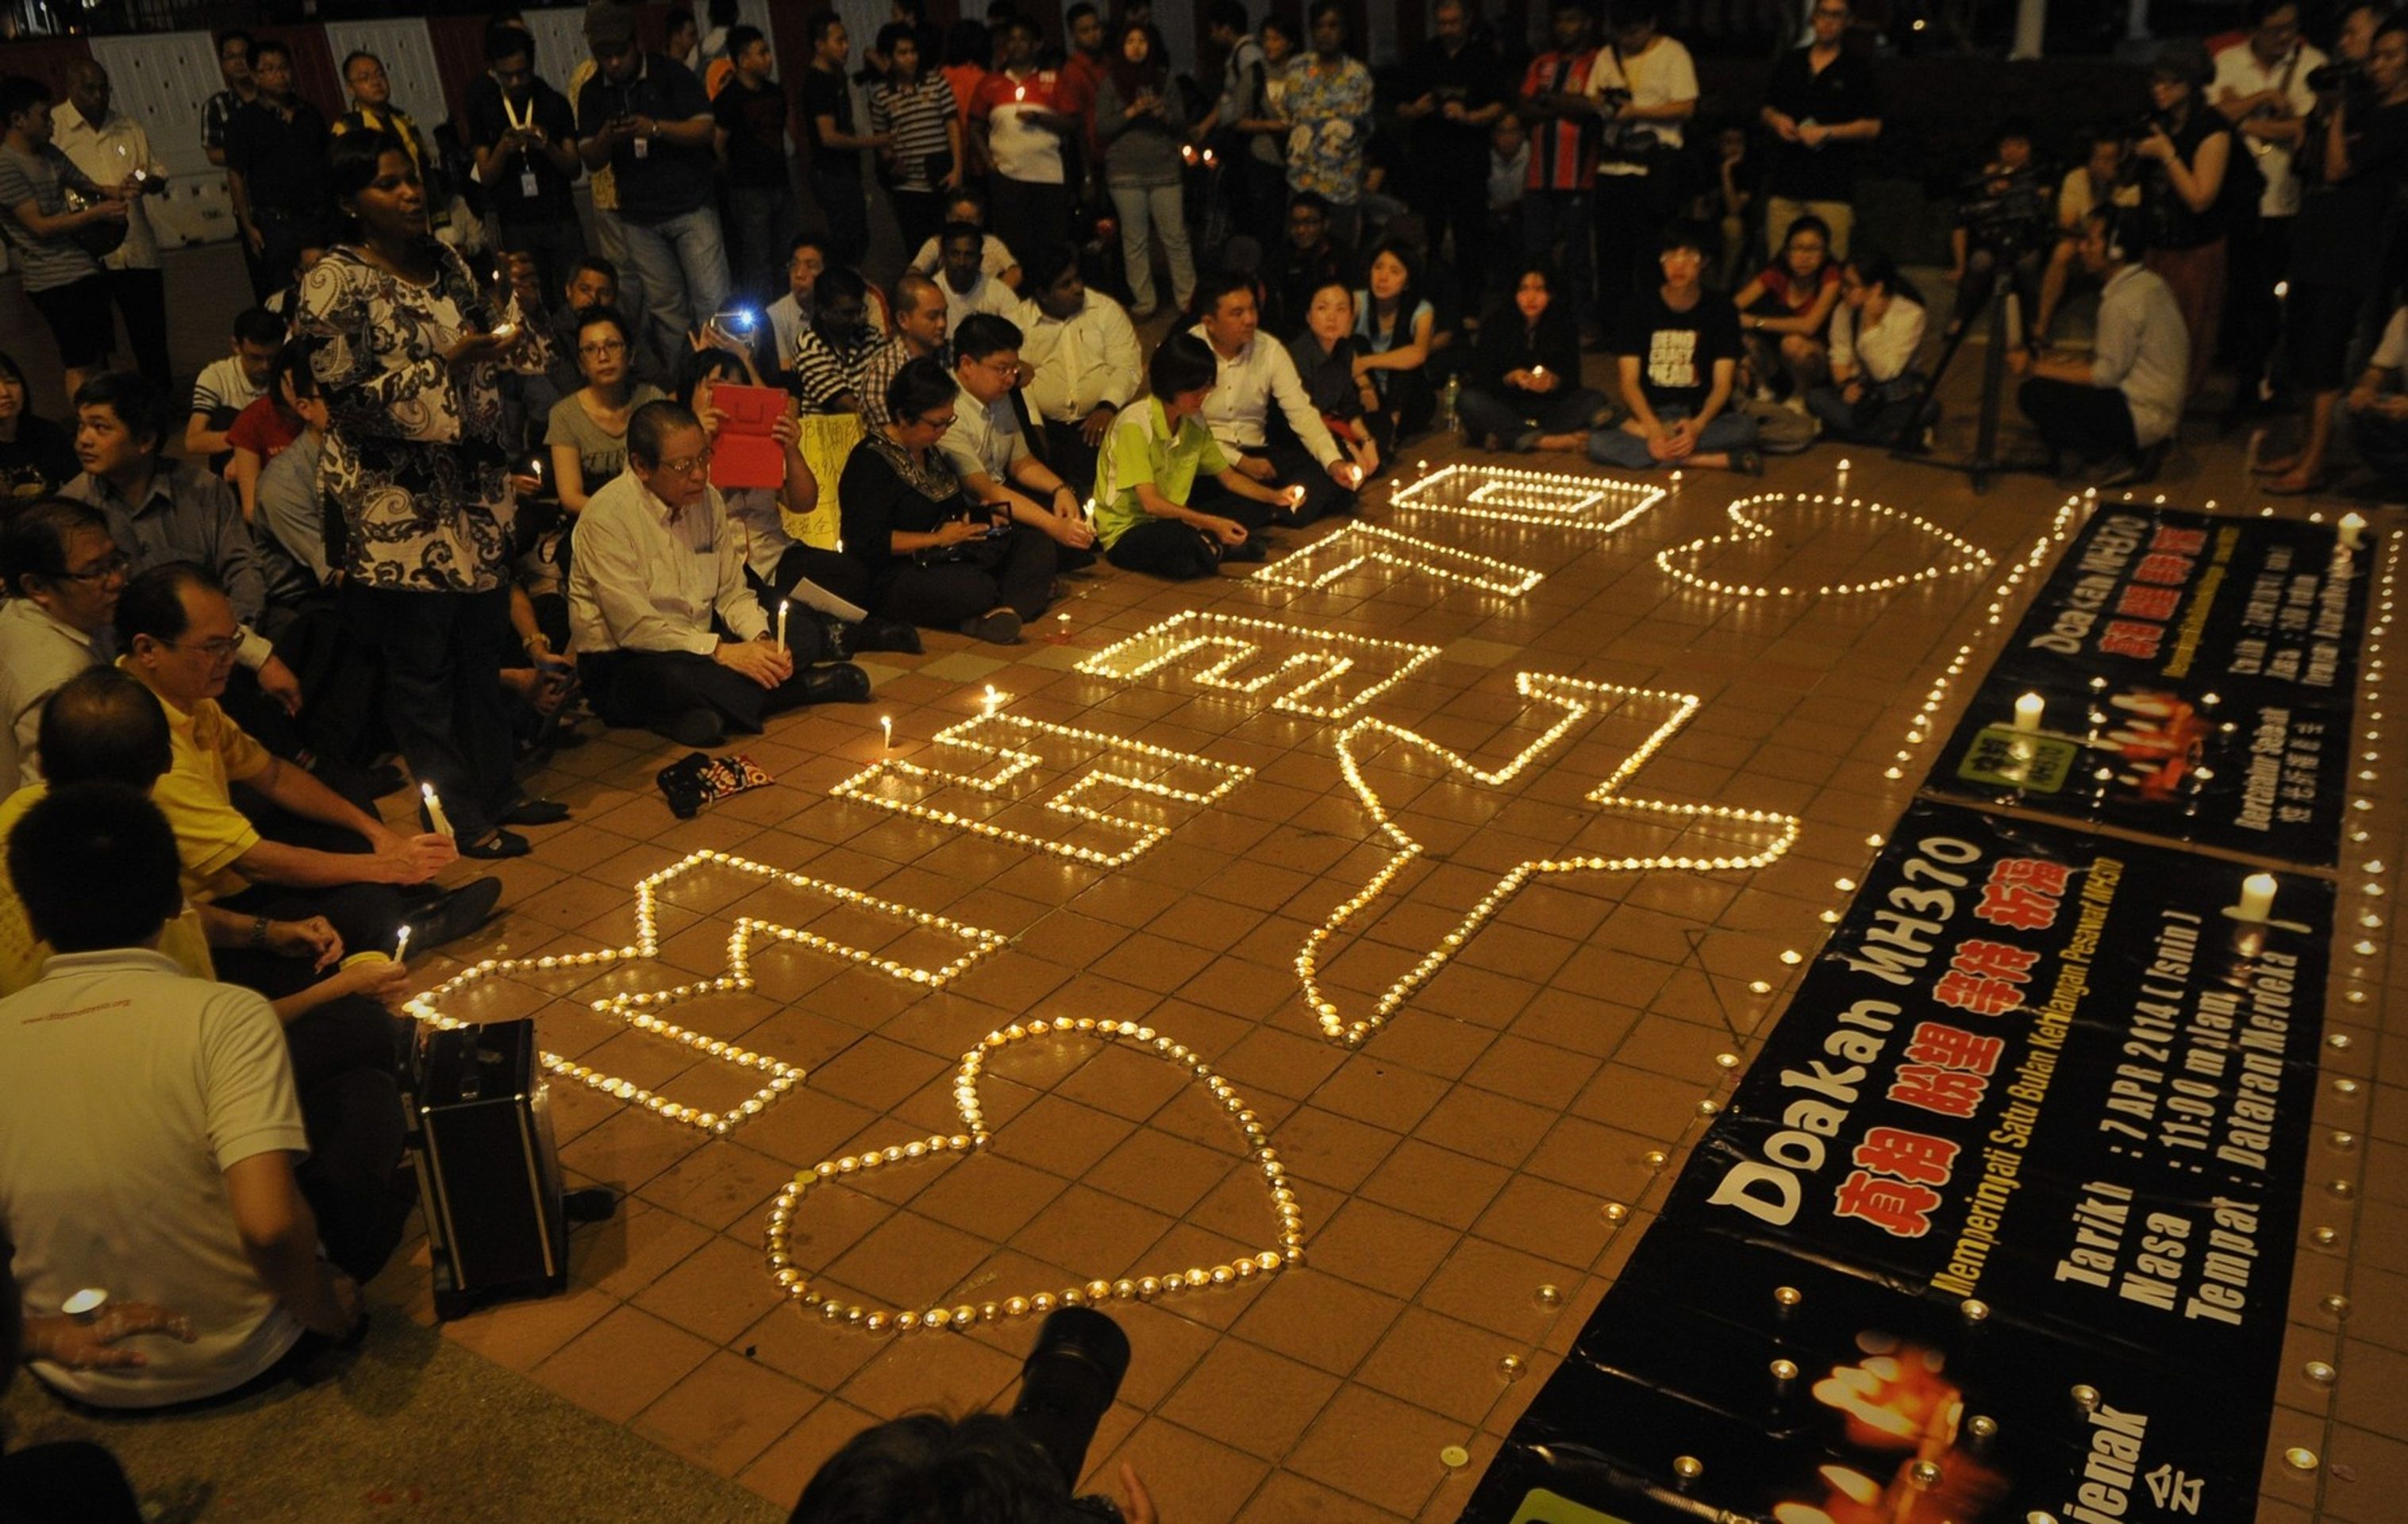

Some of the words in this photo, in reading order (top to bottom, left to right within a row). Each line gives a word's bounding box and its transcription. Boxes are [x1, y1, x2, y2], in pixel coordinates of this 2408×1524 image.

[2028, 580, 2118, 654] Doakan
[1974, 858, 2070, 930] 祈福
[2082, 857, 2124, 903] MH370
[2060, 900, 2109, 963] Pesawat
[2145, 926, 2199, 983] Isnin
[1933, 939, 2041, 1017] 等待
[2027, 964, 2090, 1049] Kehilangan
[2239, 952, 2298, 1053] Merdeka
[1706, 1000, 1902, 1226] Doakan
[1849, 837, 1981, 985] MH370
[2123, 1002, 2180, 1063] 2014
[2184, 991, 2237, 1077] malam
[1886, 1022, 2005, 1118] 盼望
[2007, 1049, 2059, 1103] Bulan
[2106, 1064, 2164, 1121] APR
[1989, 1102, 2040, 1149] Satu
[2099, 1119, 2148, 1145] 7
[2159, 1078, 2220, 1150] 11:00
[2217, 1053, 2283, 1170] Dataran
[1833, 1126, 1961, 1238] 真相
[1930, 1147, 2022, 1297] Memperingati
[2055, 1181, 2133, 1288] Tarikh
[2119, 1212, 2192, 1311] Masa
[2185, 1196, 2261, 1326] Tempat
[2145, 1463, 2206, 1516] 会
